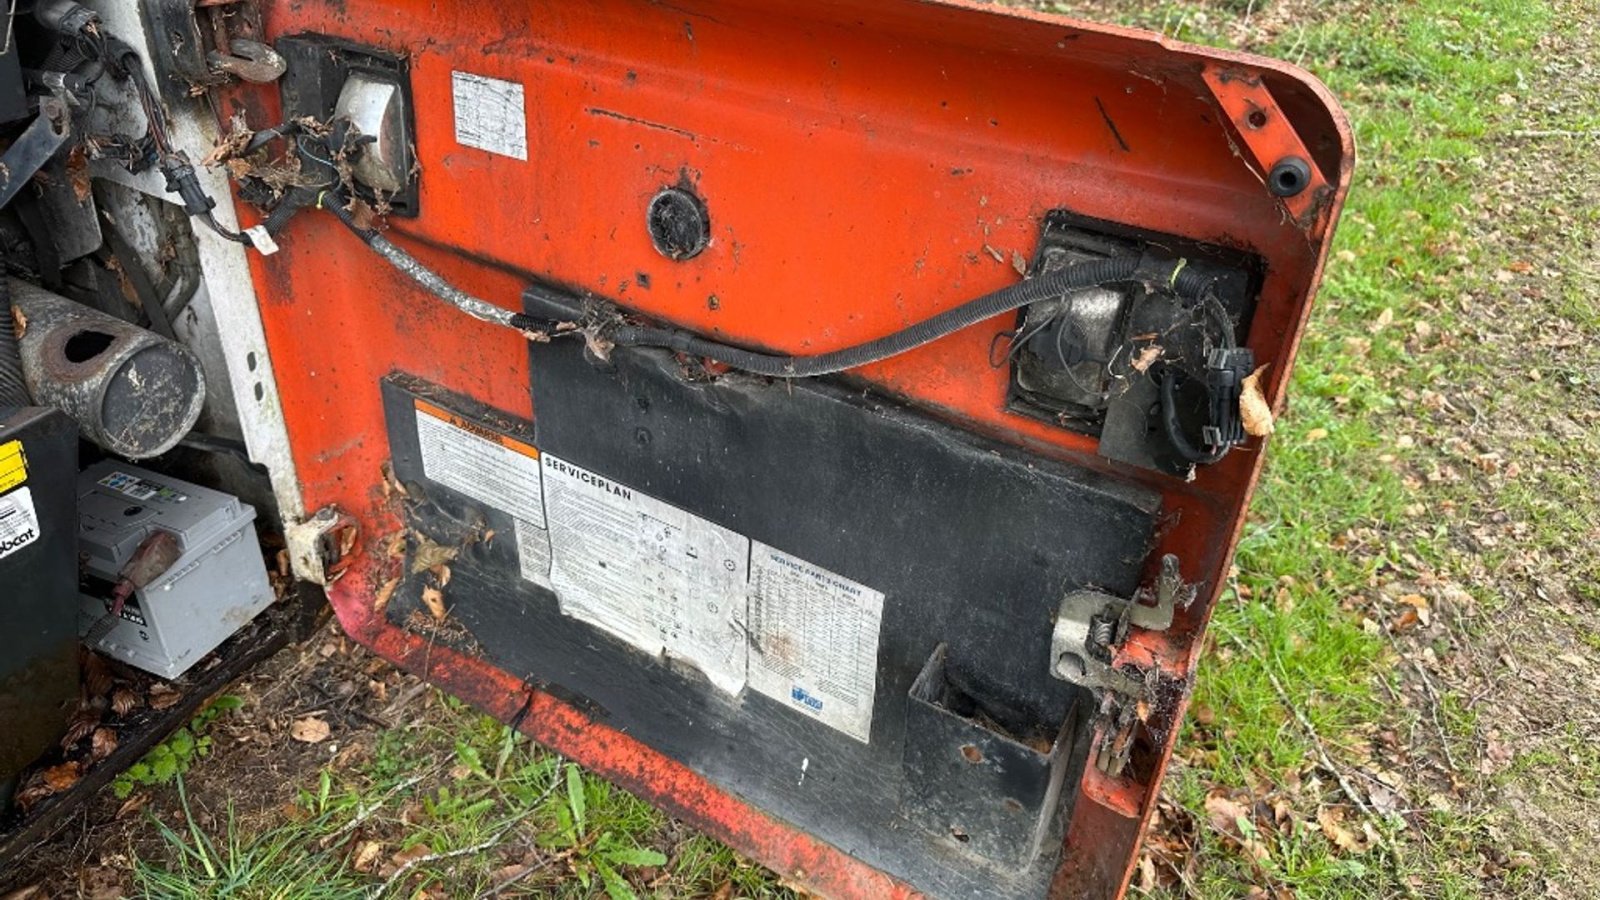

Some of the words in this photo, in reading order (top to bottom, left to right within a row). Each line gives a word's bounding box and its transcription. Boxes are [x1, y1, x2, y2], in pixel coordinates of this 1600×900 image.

[545, 457, 632, 501] SERVICEPLAN
[770, 554, 803, 573] SERVICE
[805, 568, 831, 585] PARTS
[833, 581, 862, 597] CHART
